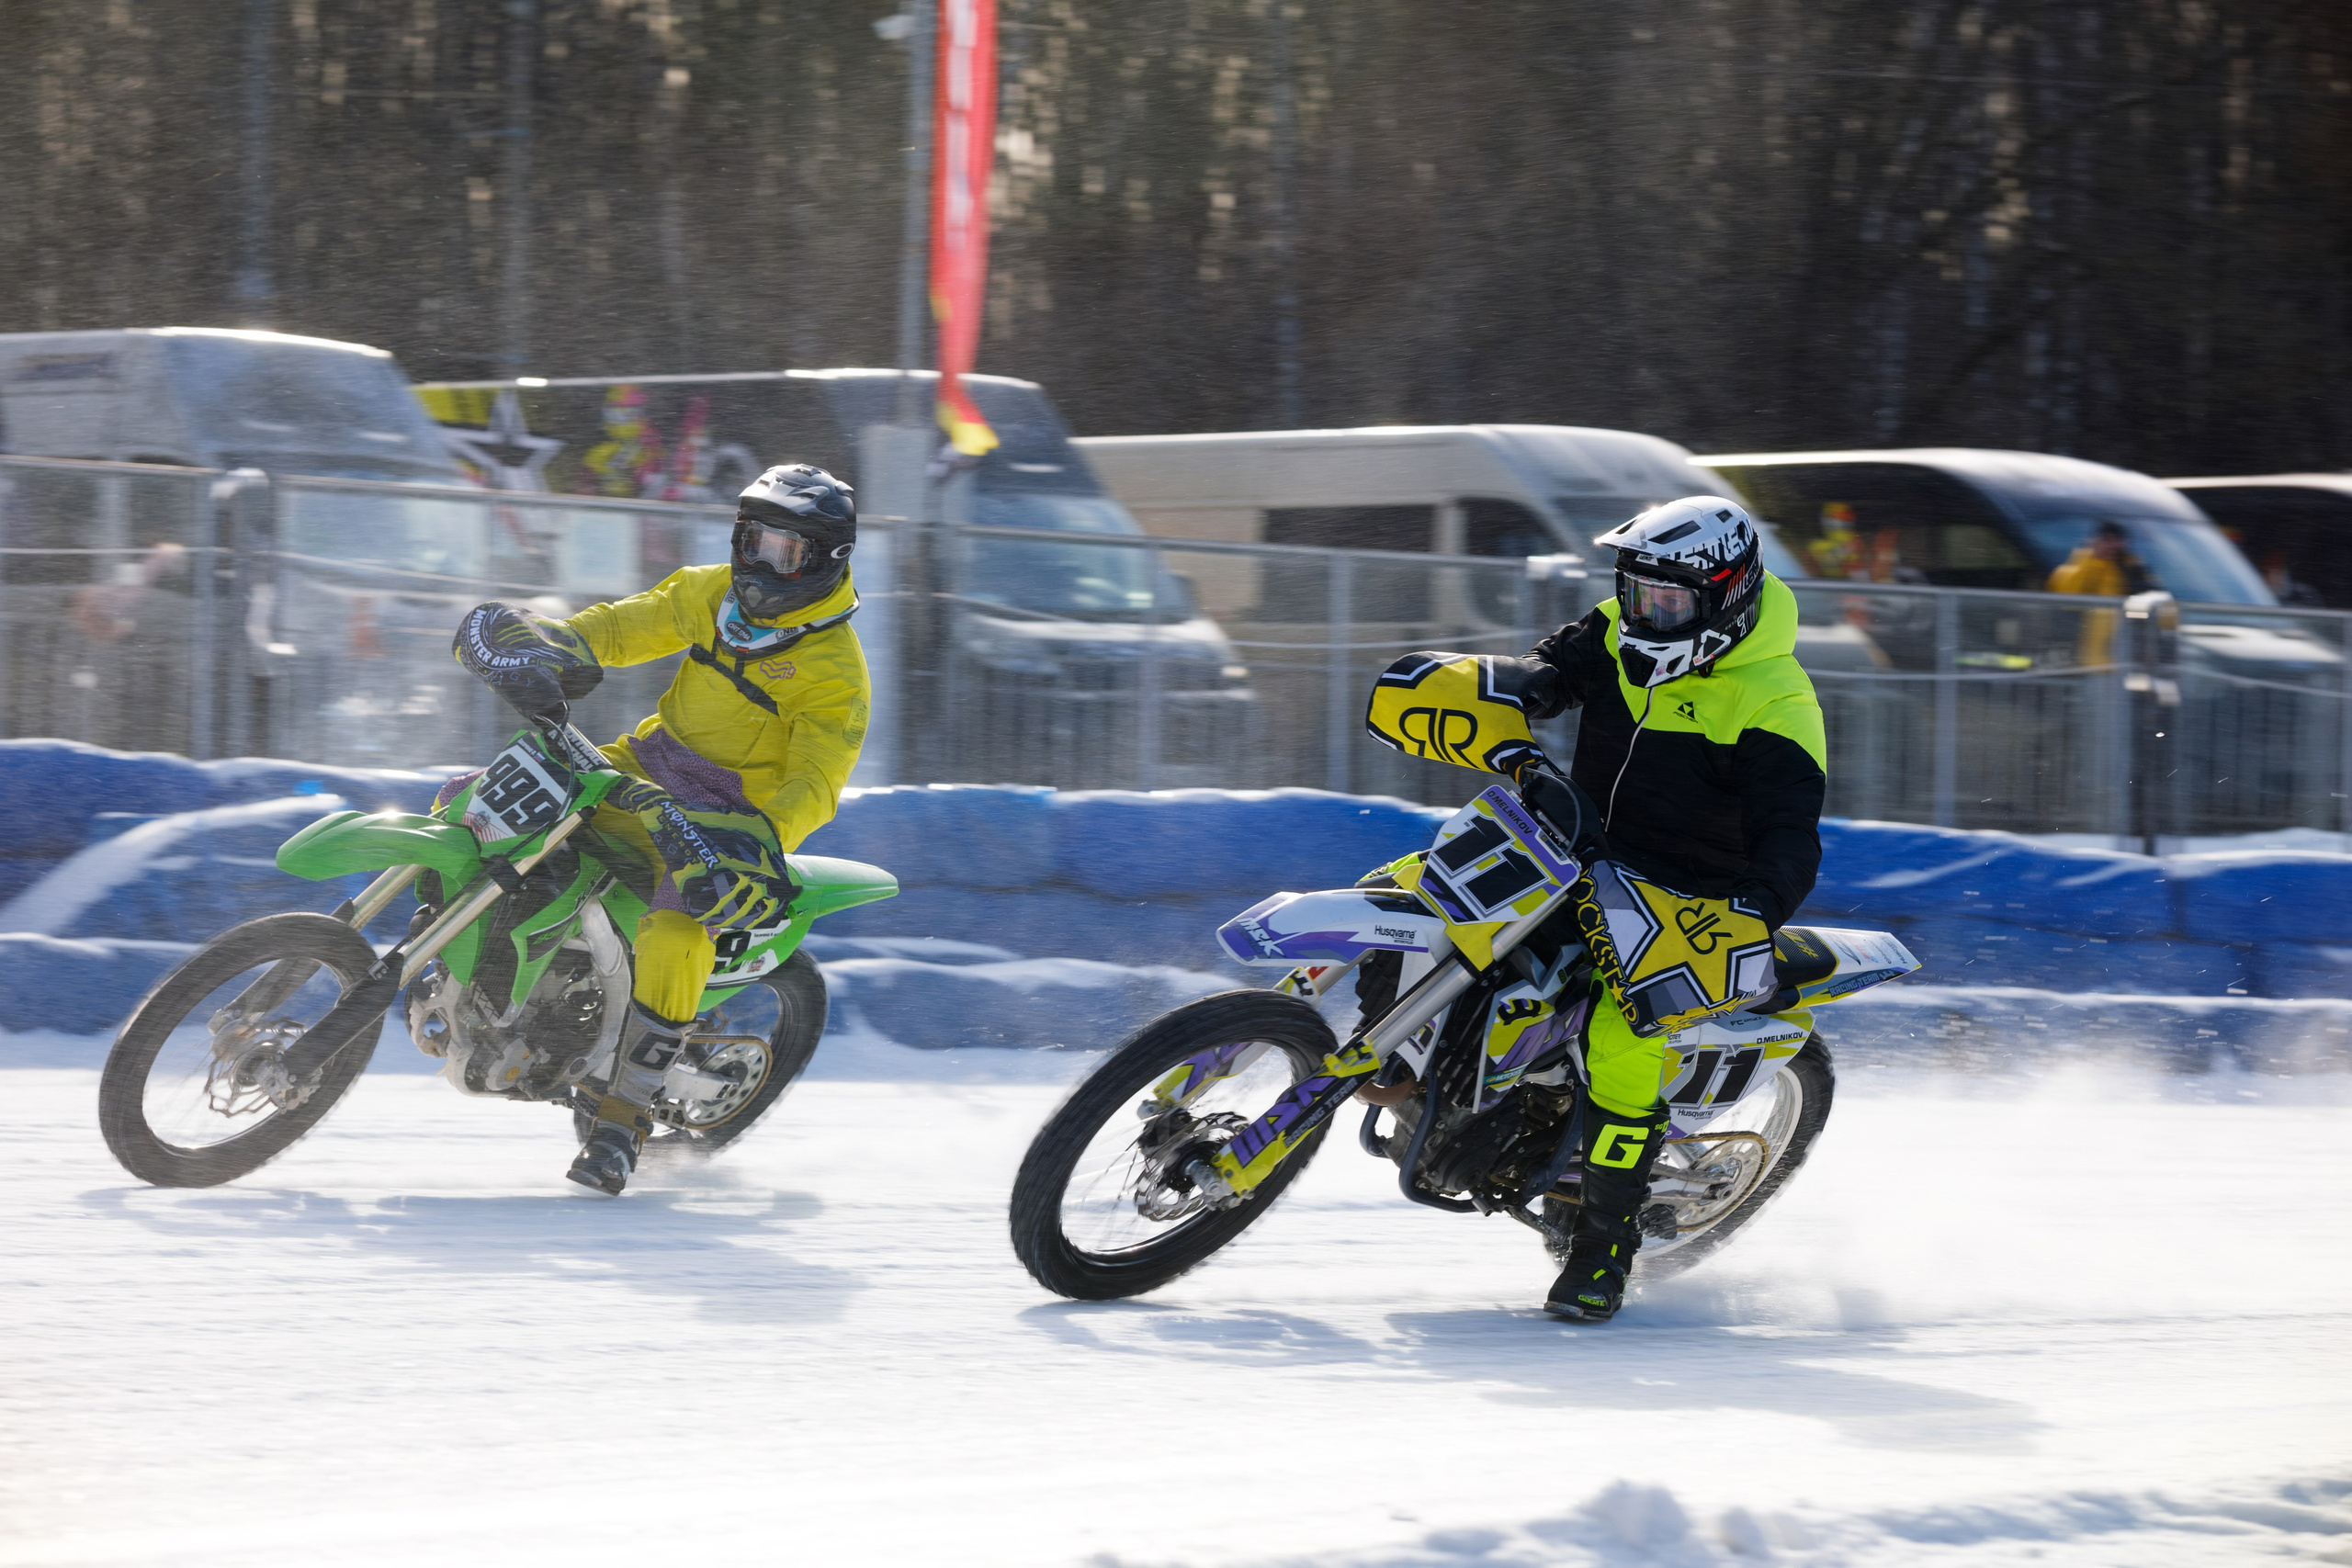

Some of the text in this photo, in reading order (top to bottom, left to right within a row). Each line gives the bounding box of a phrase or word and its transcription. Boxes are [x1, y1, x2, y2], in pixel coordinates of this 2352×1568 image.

[469, 609, 530, 667] MONSTER ARMY
[474, 753, 562, 835] 999
[1486, 790, 1534, 835] D.MELNIKOV
[1431, 813, 1550, 913] 11
[1374, 924, 1417, 939] Husqvarna
[1830, 972, 1881, 998] RACING TEAM
[1730, 1019, 1744, 1027] FC
[1756, 1031, 1804, 1045] D.MELNIKOV
[1668, 1046, 1766, 1105] 11
[1285, 1107, 1326, 1147] RACING
[1678, 1109, 1716, 1119] Husqvarna
[1589, 1123, 1649, 1169] G
